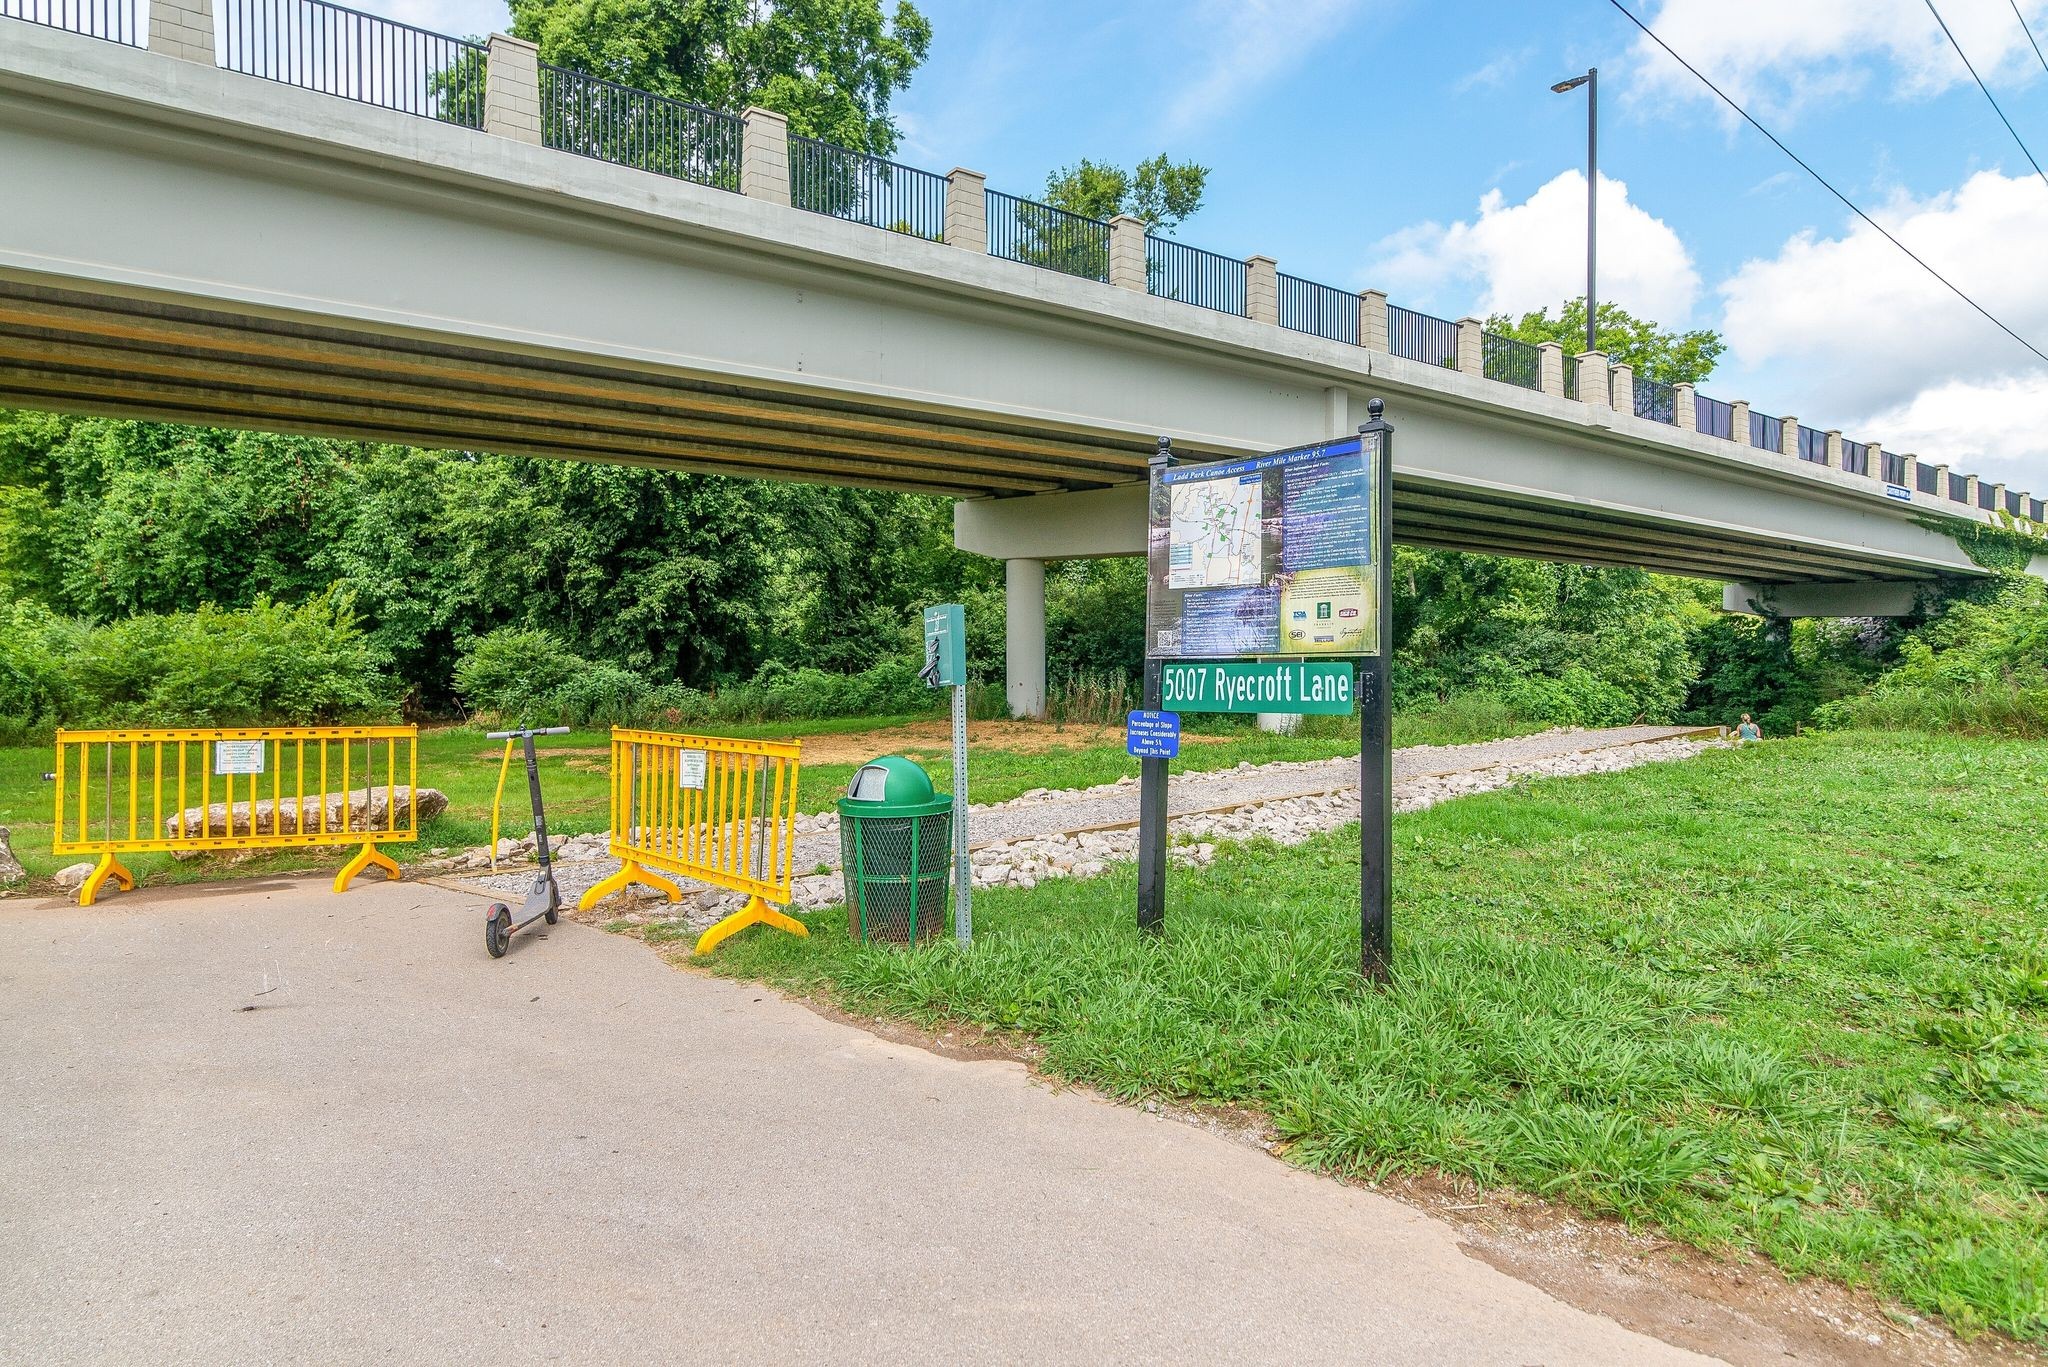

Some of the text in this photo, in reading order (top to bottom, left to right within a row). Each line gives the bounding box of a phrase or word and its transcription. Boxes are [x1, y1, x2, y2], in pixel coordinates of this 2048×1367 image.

[1190, 471, 1204, 479] Park
[1206, 469, 1224, 477] Canoe
[1226, 466, 1245, 474] Access
[1256, 461, 1272, 469] River
[1273, 457, 1286, 466] Mile
[1288, 453, 1310, 463] Marker
[1312, 449, 1326, 459] 95.7
[1165, 665, 1349, 710] 5007 Ryecroft Lane
[1160, 721, 1173, 729] Slope
